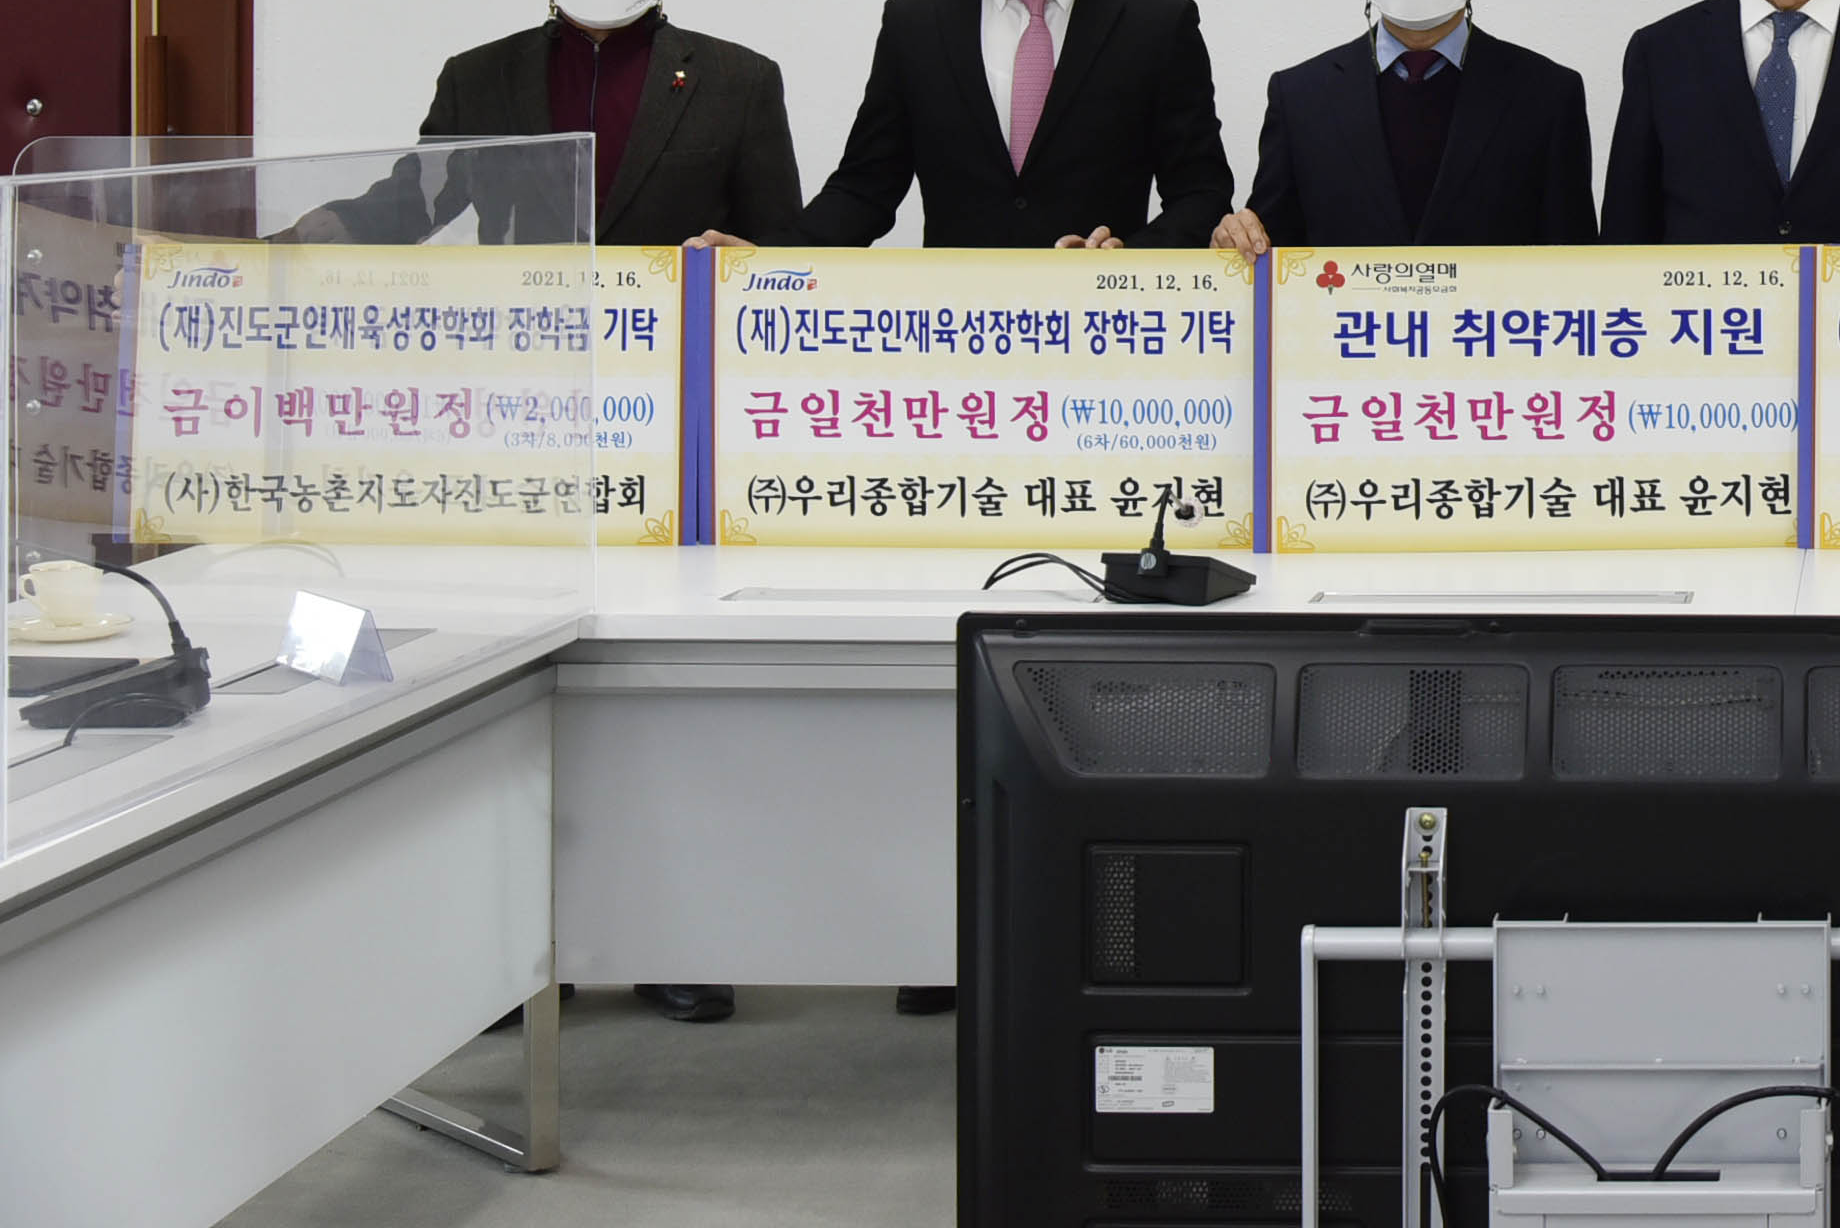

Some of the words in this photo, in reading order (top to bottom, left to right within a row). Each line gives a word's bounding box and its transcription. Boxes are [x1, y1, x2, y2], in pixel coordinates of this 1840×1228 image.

[167, 268, 231, 289] Jindo
[743, 272, 805, 291] Jindo
[1096, 274, 1144, 291] 2021.
[1155, 274, 1181, 291] 12.
[1192, 274, 1218, 291] 16.
[1351, 262, 1458, 285] 사랑의열매
[1663, 270, 1711, 288] 2021.
[1722, 270, 1748, 288] 12.
[1759, 270, 1785, 288] 16.
[736, 305, 1071, 356] (재)진도군인재육성장학회
[1083, 309, 1167, 356] 장학금
[1180, 309, 1236, 356] 기탁
[1333, 308, 1429, 359] 관내
[1452, 307, 1648, 359] 취약계층
[1669, 306, 1765, 356] 지원
[163, 384, 473, 439] 금이백만원정
[744, 388, 1049, 442] 금일천만원정
[1302, 390, 1618, 444] 금일천만원정
[1025, 476, 1097, 517] 대표
[1110, 475, 1226, 518] 윤지현
[1592, 476, 1667, 518] 대표
[1679, 473, 1793, 518] 윤지현
